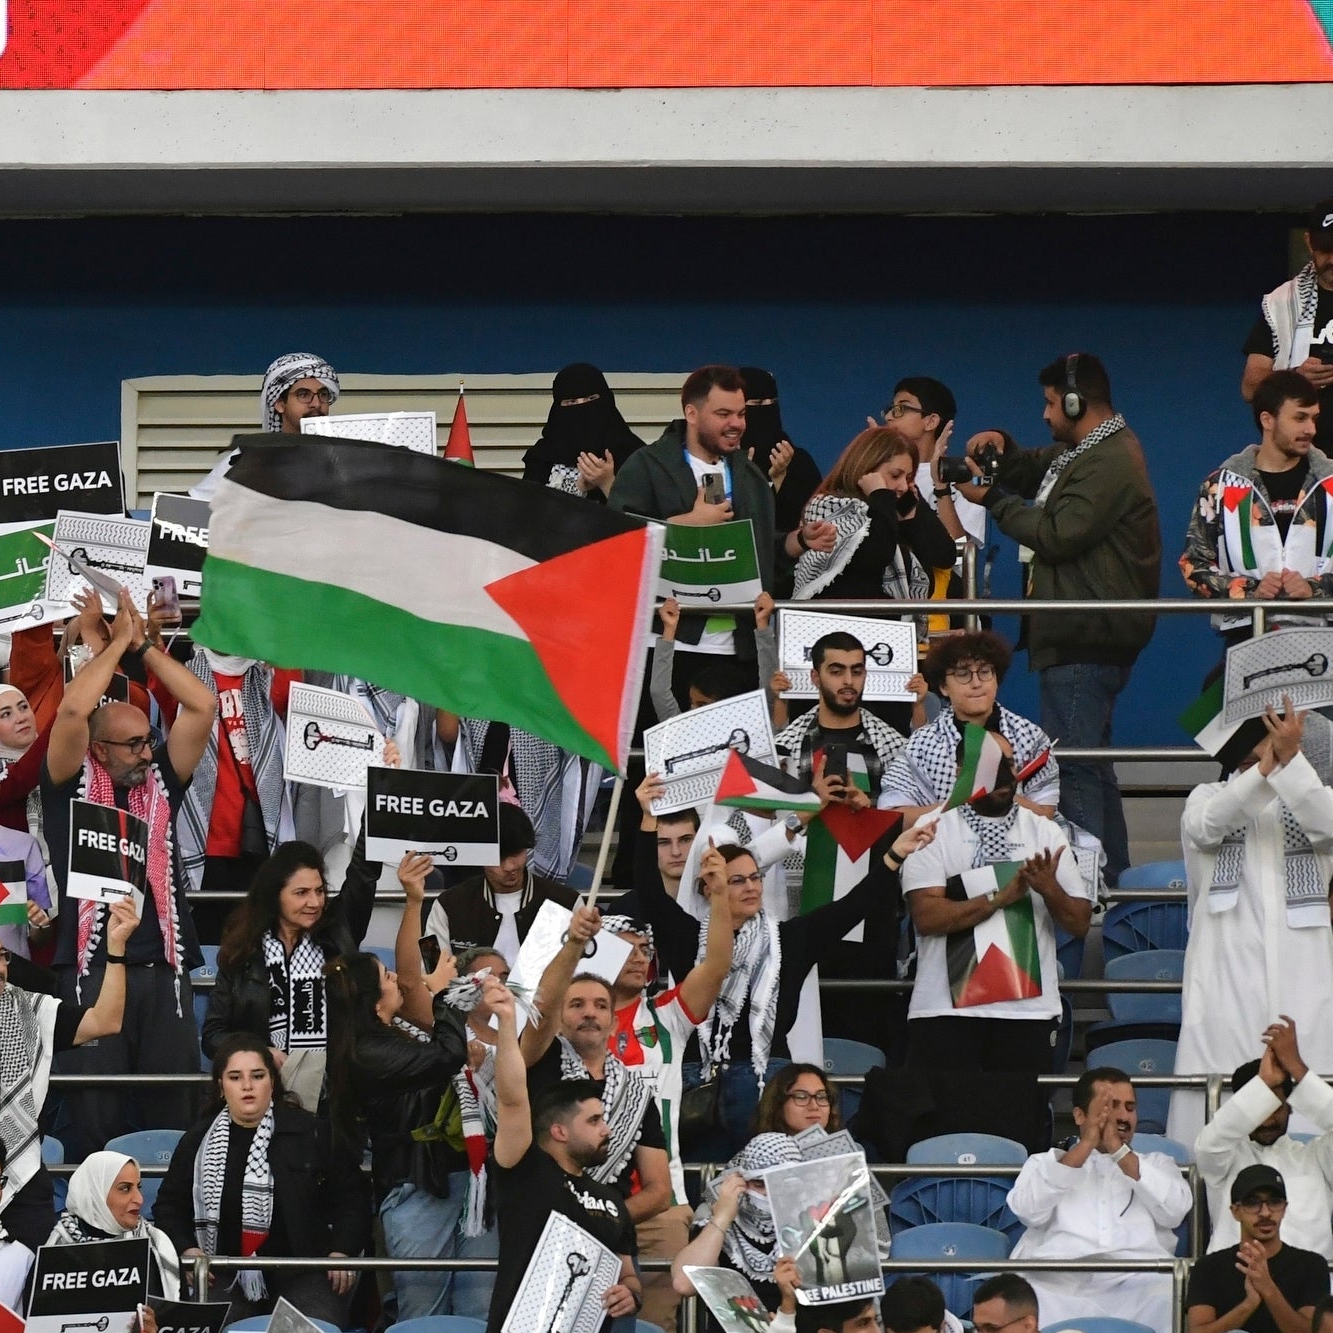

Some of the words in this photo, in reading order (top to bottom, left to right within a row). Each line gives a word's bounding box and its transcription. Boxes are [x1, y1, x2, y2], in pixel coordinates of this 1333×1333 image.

[2, 475, 49, 495] FREE
[54, 471, 112, 491] GAZA
[159, 522, 209, 547] FREE
[662, 547, 737, 563] عائدو
[374, 794, 424, 815] FREE
[427, 798, 490, 819] GAZA
[78, 828, 117, 853] FREE
[119, 838, 146, 865] GAZA
[200, 967, 213, 976] 36
[300, 981, 315, 1031] فلسطين
[42, 1269, 87, 1292] FREE
[91, 1266, 141, 1289] GAZA
[821, 1278, 882, 1300] PALESTINE
